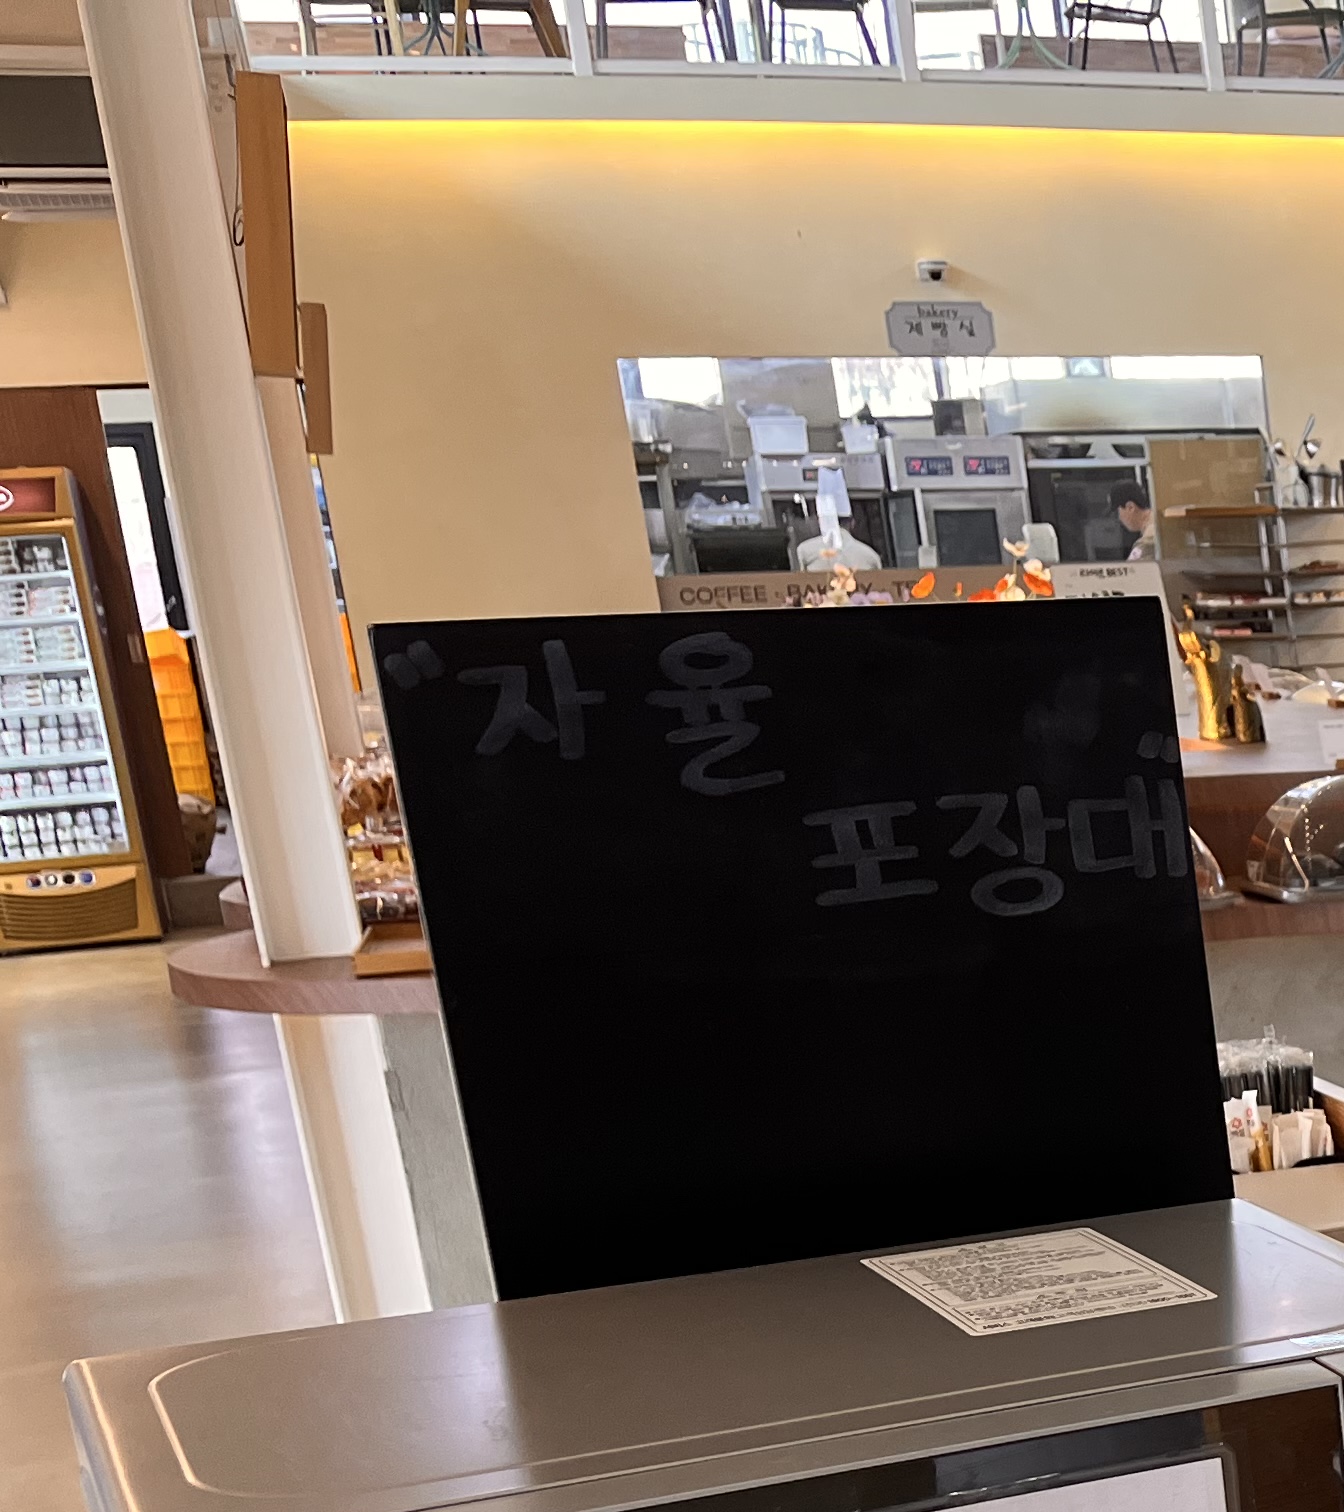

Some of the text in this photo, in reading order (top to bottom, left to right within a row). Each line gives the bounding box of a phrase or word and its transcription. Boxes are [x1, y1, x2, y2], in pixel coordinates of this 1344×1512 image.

[917, 304, 958, 320] bakery
[680, 585, 766, 606] COFFEE
[787, 582, 872, 606] BAKY
